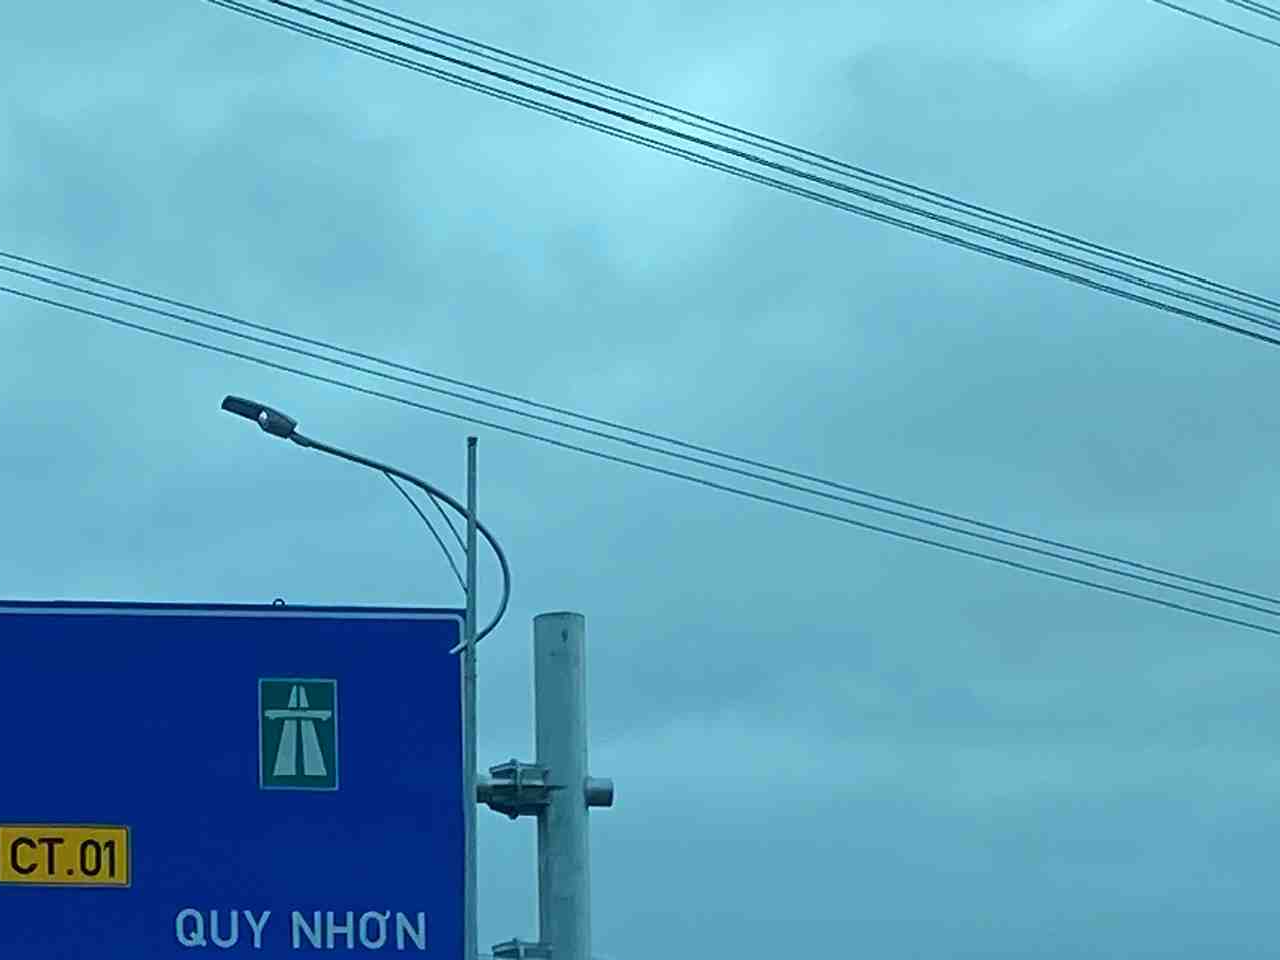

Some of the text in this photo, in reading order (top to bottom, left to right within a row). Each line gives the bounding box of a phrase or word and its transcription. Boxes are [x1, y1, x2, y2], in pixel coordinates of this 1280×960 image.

[10, 836, 116, 878] CT.01
[175, 908, 426, 950] QUY NHƠN
